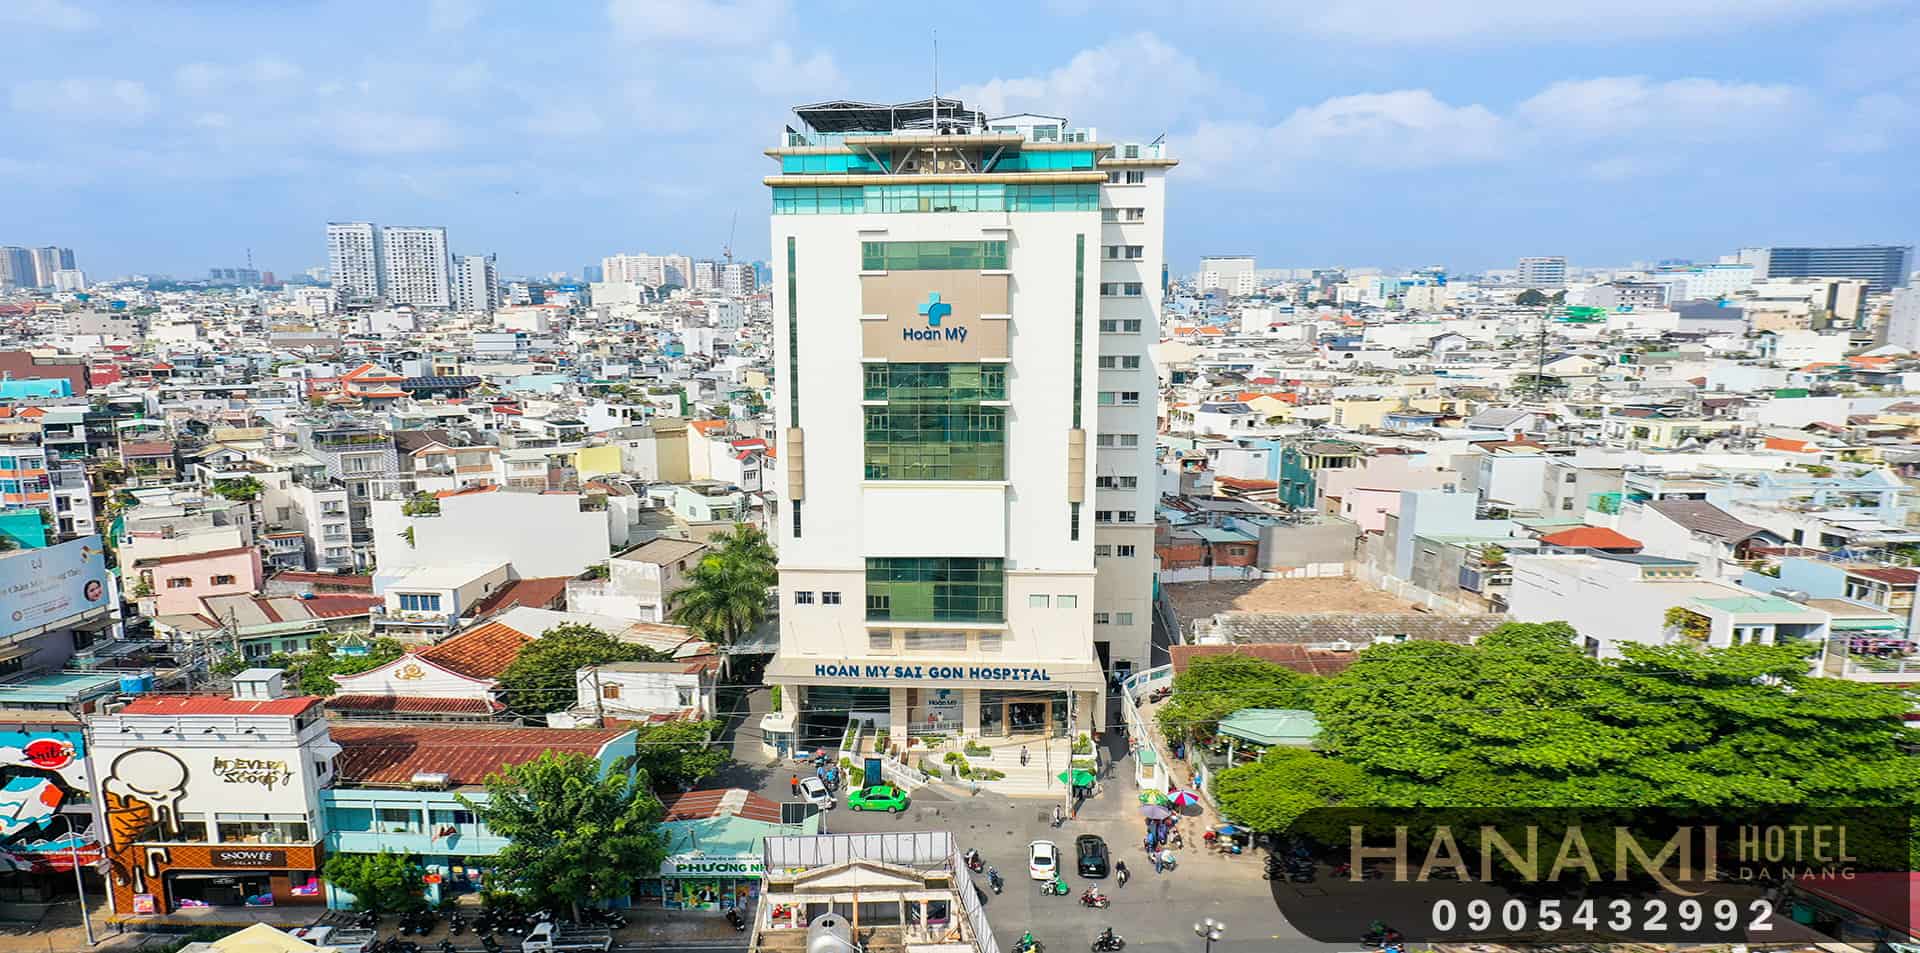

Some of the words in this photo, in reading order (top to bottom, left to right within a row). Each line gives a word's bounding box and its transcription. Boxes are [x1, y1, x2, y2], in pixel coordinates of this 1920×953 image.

[903, 326, 941, 341] Hoàn
[945, 326, 967, 343] Mỹ
[815, 664, 860, 677] HOAN
[866, 666, 890, 678] MY
[894, 666, 923, 679] SAI
[928, 667, 964, 679] GON
[969, 667, 1050, 681] HOSPITAL
